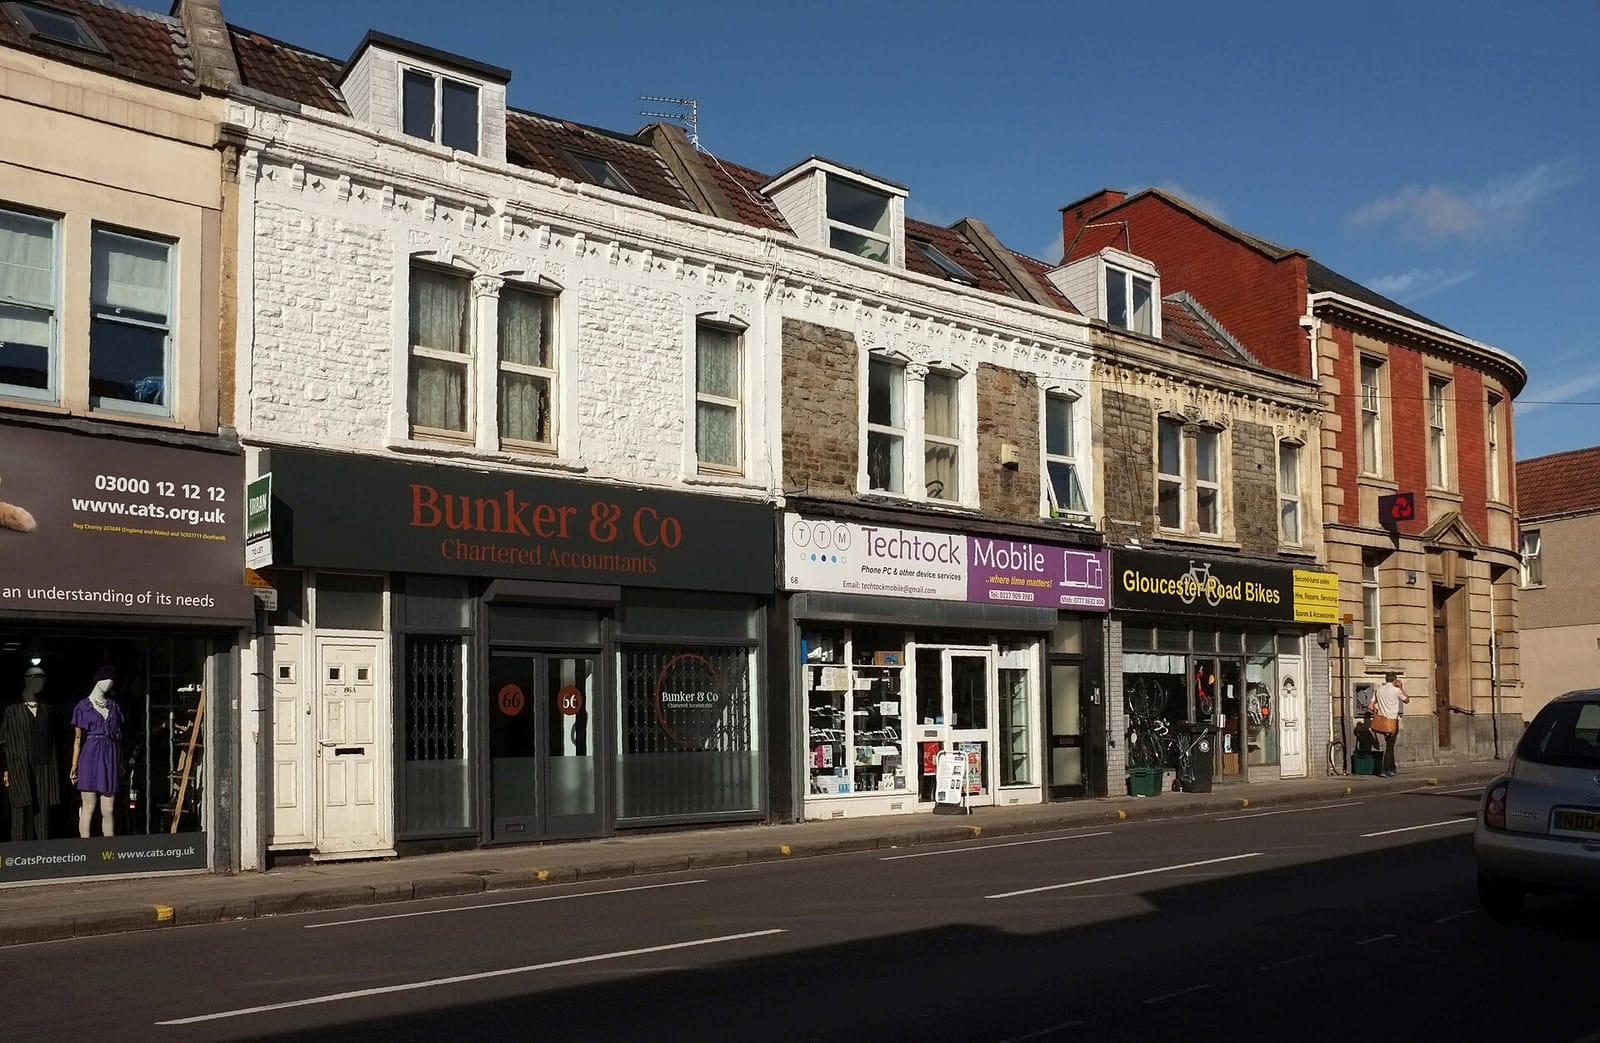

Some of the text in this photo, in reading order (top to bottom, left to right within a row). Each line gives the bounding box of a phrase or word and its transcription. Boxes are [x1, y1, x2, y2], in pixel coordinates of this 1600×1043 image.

[95, 475, 226, 502] 03000 12 12 12
[72, 498, 226, 524] www.cats.org.uk
[408, 484, 682, 548] Bunker & Co
[440, 538, 657, 574] Chartered Accountants
[861, 526, 1044, 572] Techtock Mobile
[790, 576, 799, 585] 68
[861, 564, 961, 581] Phone PC & other device services
[1011, 576, 1025, 586] time
[1026, 579, 1053, 588] matters!
[2, 586, 215, 607] an understanding of its needs
[842, 580, 937, 595] Email: techtockmobile@gmail.com
[1122, 569, 1281, 604] Gloucester Road Bikes
[503, 693, 520, 708] 66
[662, 691, 719, 702] Bunker & Co
[5, 846, 195, 867] @CatsProtection W: www.cats.org.uk
